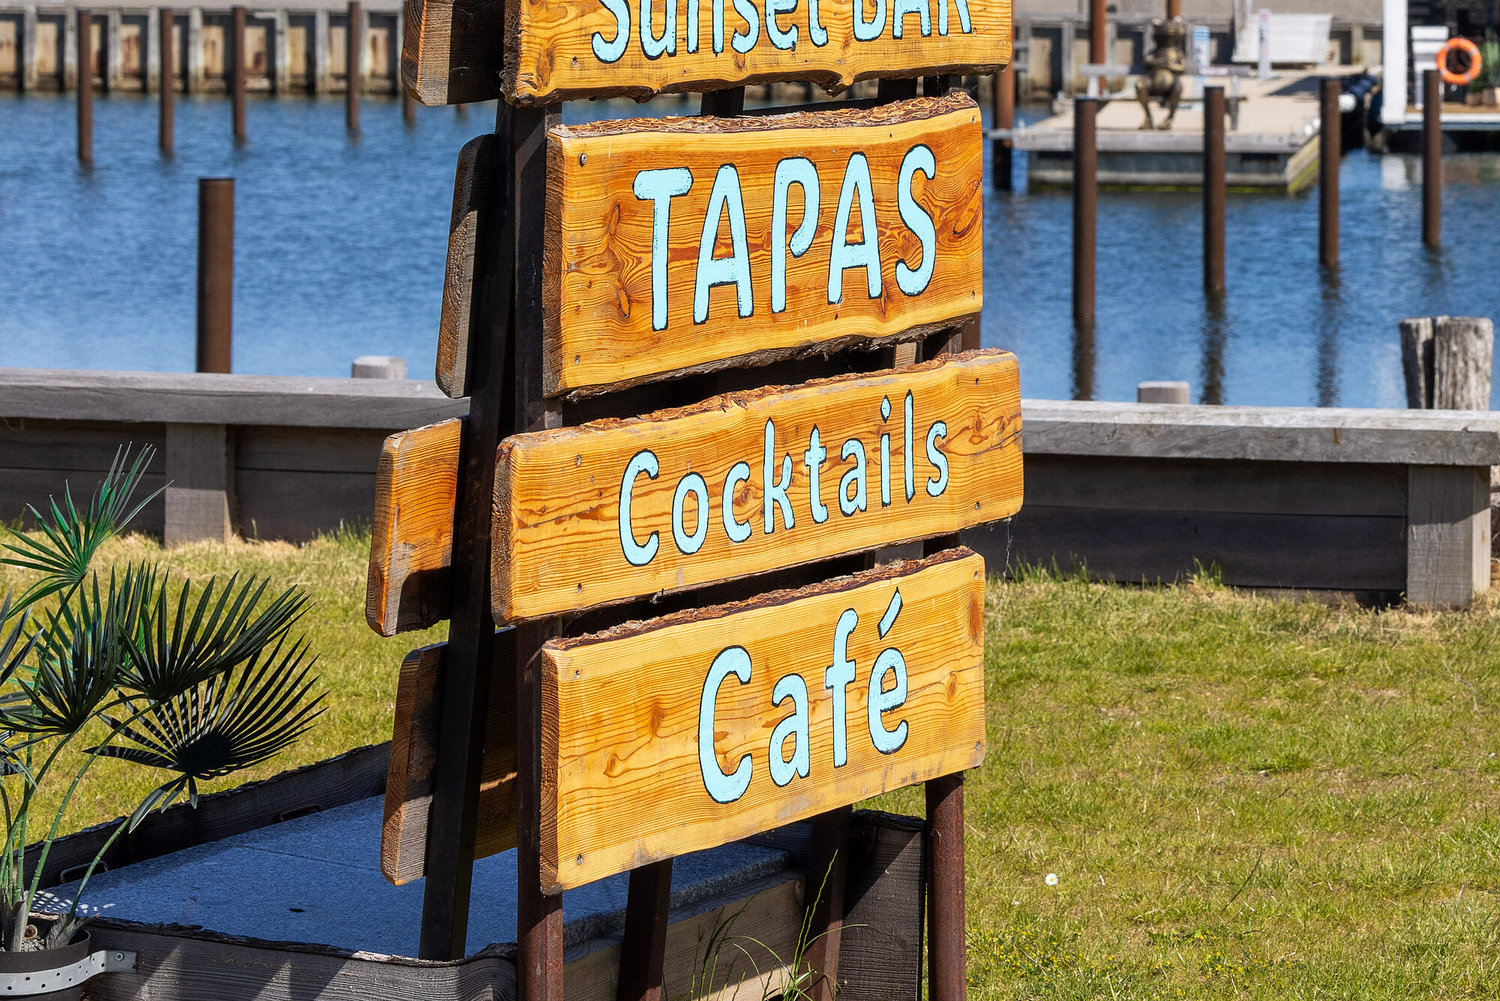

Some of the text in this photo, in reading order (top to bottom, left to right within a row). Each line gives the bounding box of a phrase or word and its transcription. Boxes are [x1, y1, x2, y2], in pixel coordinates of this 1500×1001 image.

[633, 144, 937, 331] TAPAS
[619, 389, 949, 566] Cocktails
[699, 587, 909, 803] Café
